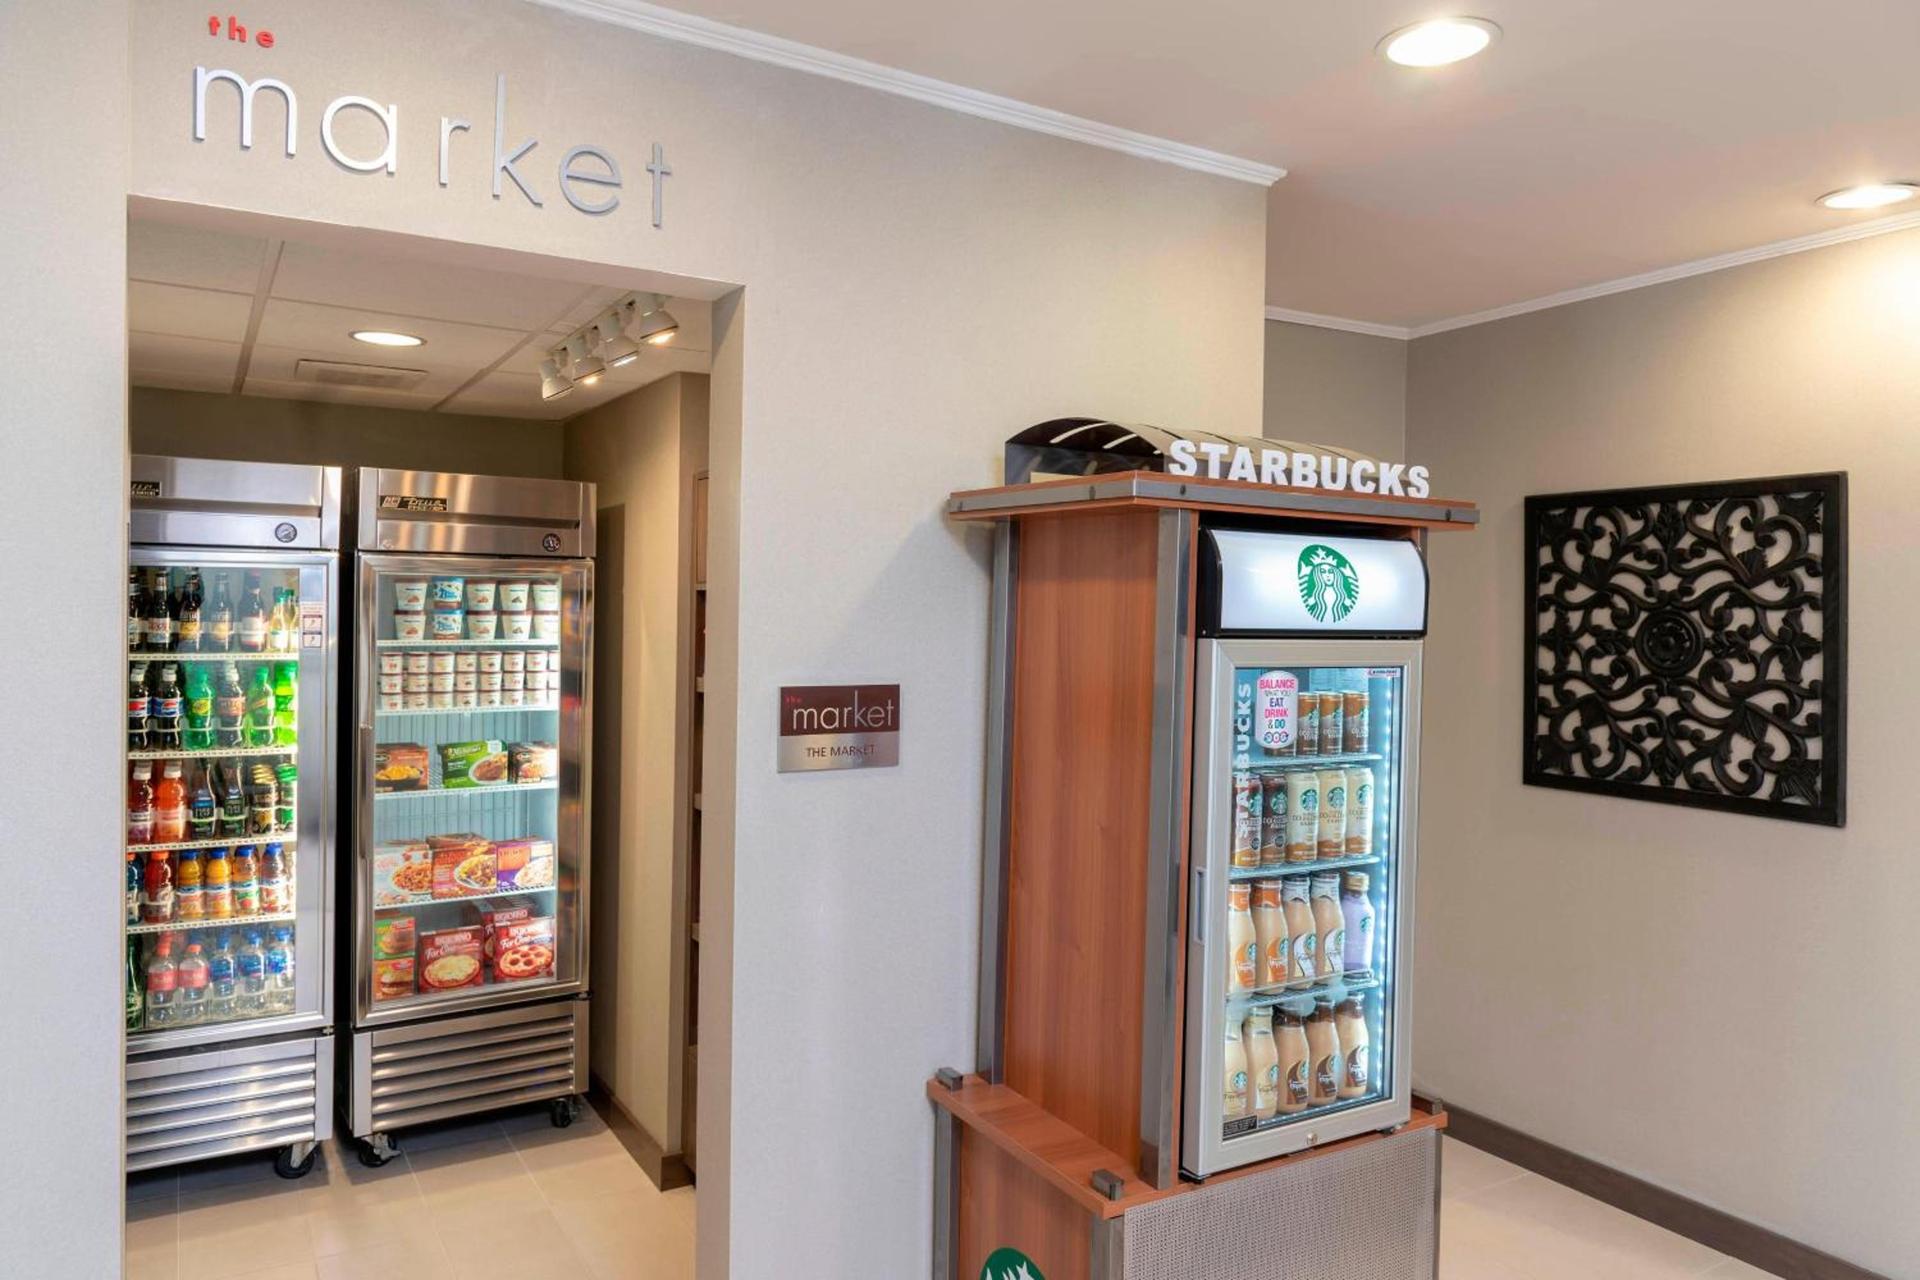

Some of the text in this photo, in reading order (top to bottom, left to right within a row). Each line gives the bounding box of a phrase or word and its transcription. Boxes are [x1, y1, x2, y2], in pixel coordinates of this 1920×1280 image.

[208, 15, 275, 49] the
[193, 65, 672, 229] market
[1168, 440, 1431, 499] STARBUCKS
[1259, 679, 1295, 689] BALANCE
[792, 689, 895, 730] market
[1264, 708, 1289, 719] DRINK
[1269, 697, 1285, 707] EAT
[1267, 719, 1286, 729] & DO
[806, 743, 875, 758] THE MARKET
[1236, 684, 1251, 838] STARBUCKS
